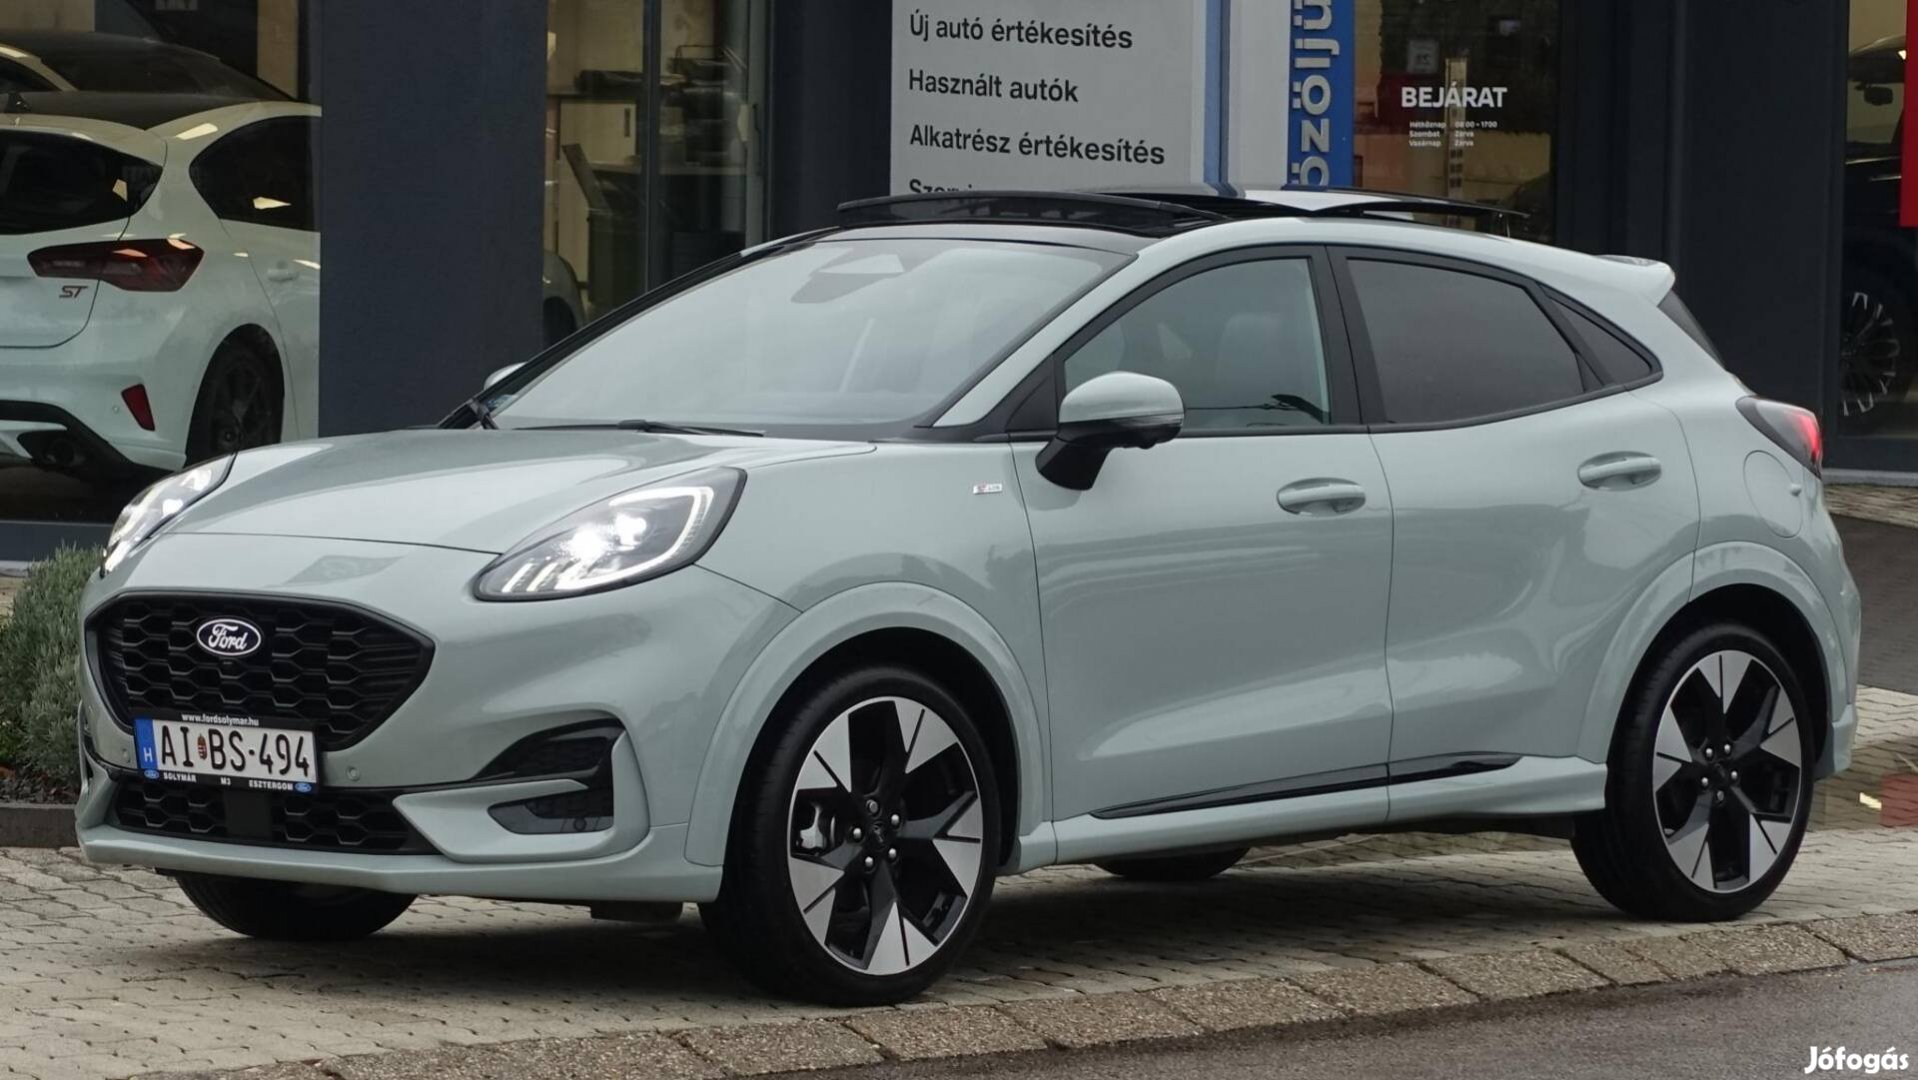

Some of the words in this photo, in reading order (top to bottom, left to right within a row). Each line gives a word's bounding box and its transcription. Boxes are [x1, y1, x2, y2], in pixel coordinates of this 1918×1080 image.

[910, 9, 929, 41] Új
[936, 17, 983, 40] autó
[991, 19, 1133, 49] értékesítés
[909, 69, 1002, 98] Használt
[1009, 79, 1079, 103] autók
[1401, 81, 1508, 108] BEJÁRAT
[910, 124, 1011, 154] Alkatrész
[1018, 132, 1165, 165] értékesítés
[1409, 130, 1440, 138] Szombat
[59, 285, 88, 298] ST
[208, 623, 248, 650] Ford
[181, 713, 259, 727] www.fordsolymar.hu
[143, 747, 153, 762] H
[161, 725, 194, 767] AI
[221, 777, 231, 786] M3
[249, 780, 294, 790] ESZTERGOM
